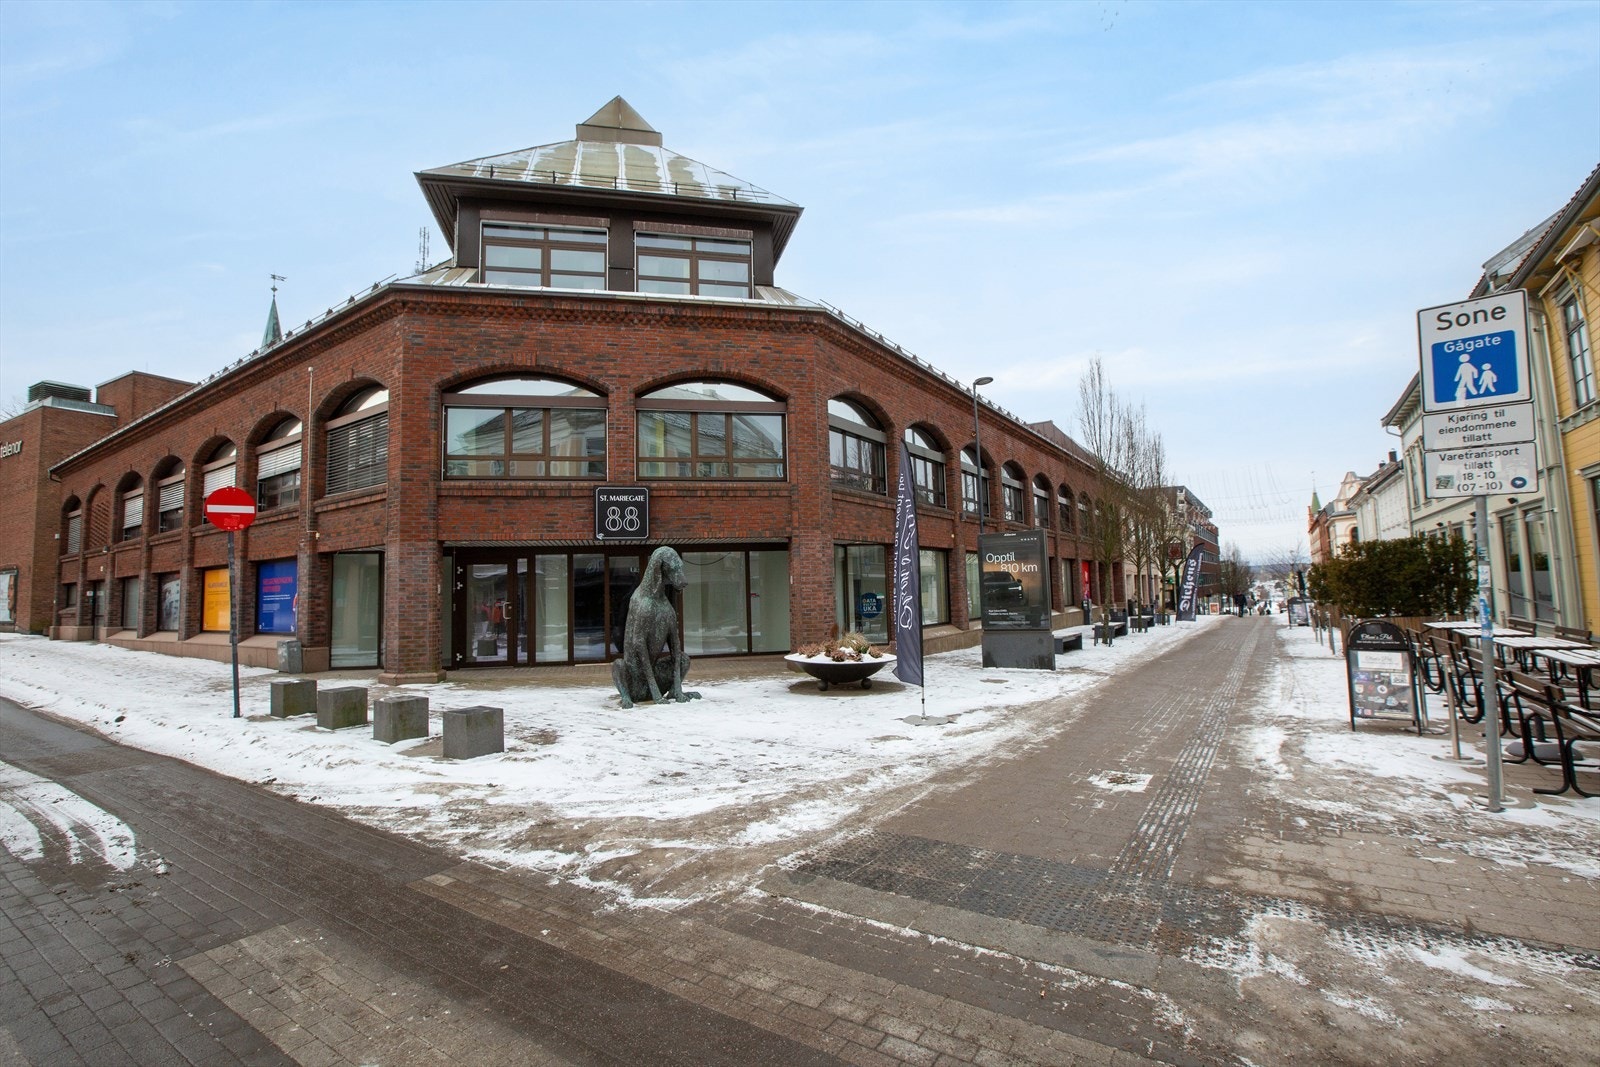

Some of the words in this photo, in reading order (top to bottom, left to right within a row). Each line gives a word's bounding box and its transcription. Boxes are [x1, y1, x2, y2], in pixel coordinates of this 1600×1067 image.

[1437, 306, 1507, 331] Sone
[1444, 336, 1502, 353] Gågate
[1448, 411, 1487, 424] Kjøring
[1494, 409, 1505, 418] til
[1438, 420, 1516, 435] eiendommene
[1462, 433, 1492, 443] tillatt
[1439, 448, 1519, 462] Varetransport
[1464, 461, 1493, 470] tillatt
[606, 506, 640, 531] 88
[986, 552, 1015, 564] Opptil
[1001, 563, 1019, 573] 810
[1021, 563, 1038, 572] km
[1180, 558, 1197, 611] Dickens
